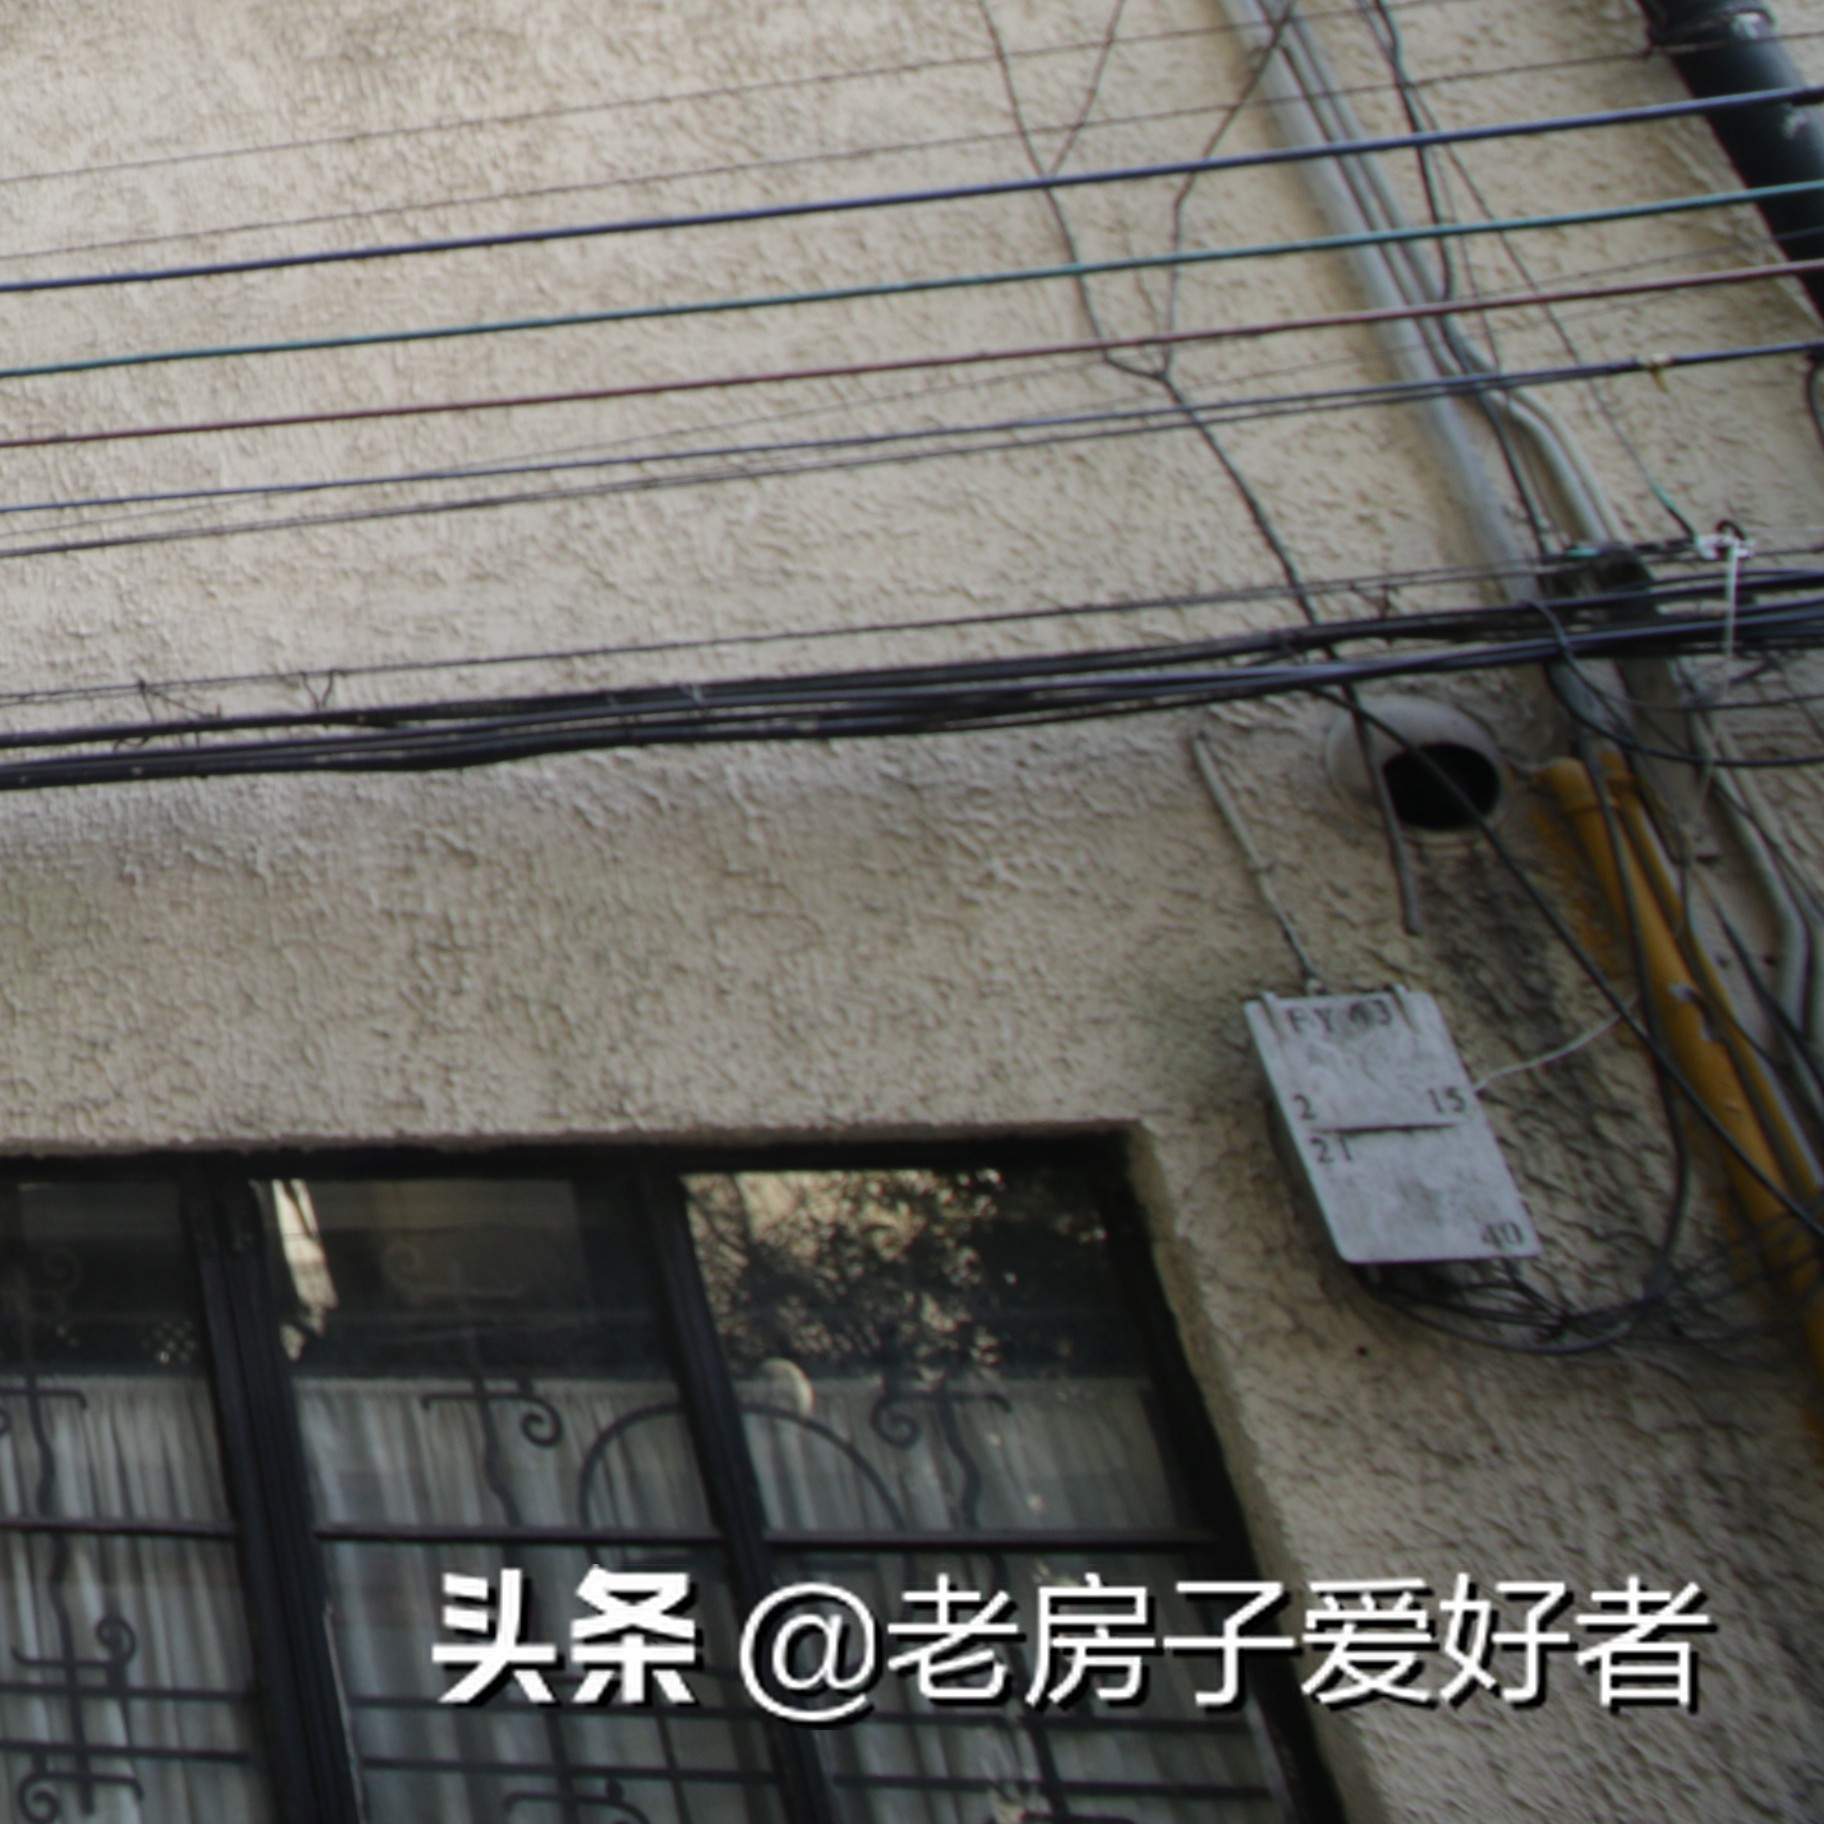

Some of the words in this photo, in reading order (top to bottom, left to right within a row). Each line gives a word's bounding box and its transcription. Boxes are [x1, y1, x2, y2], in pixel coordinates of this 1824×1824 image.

[1292, 1093, 1315, 1120] 2
[1427, 1087, 1466, 1114] 15
[1309, 1136, 1352, 1164] 21
